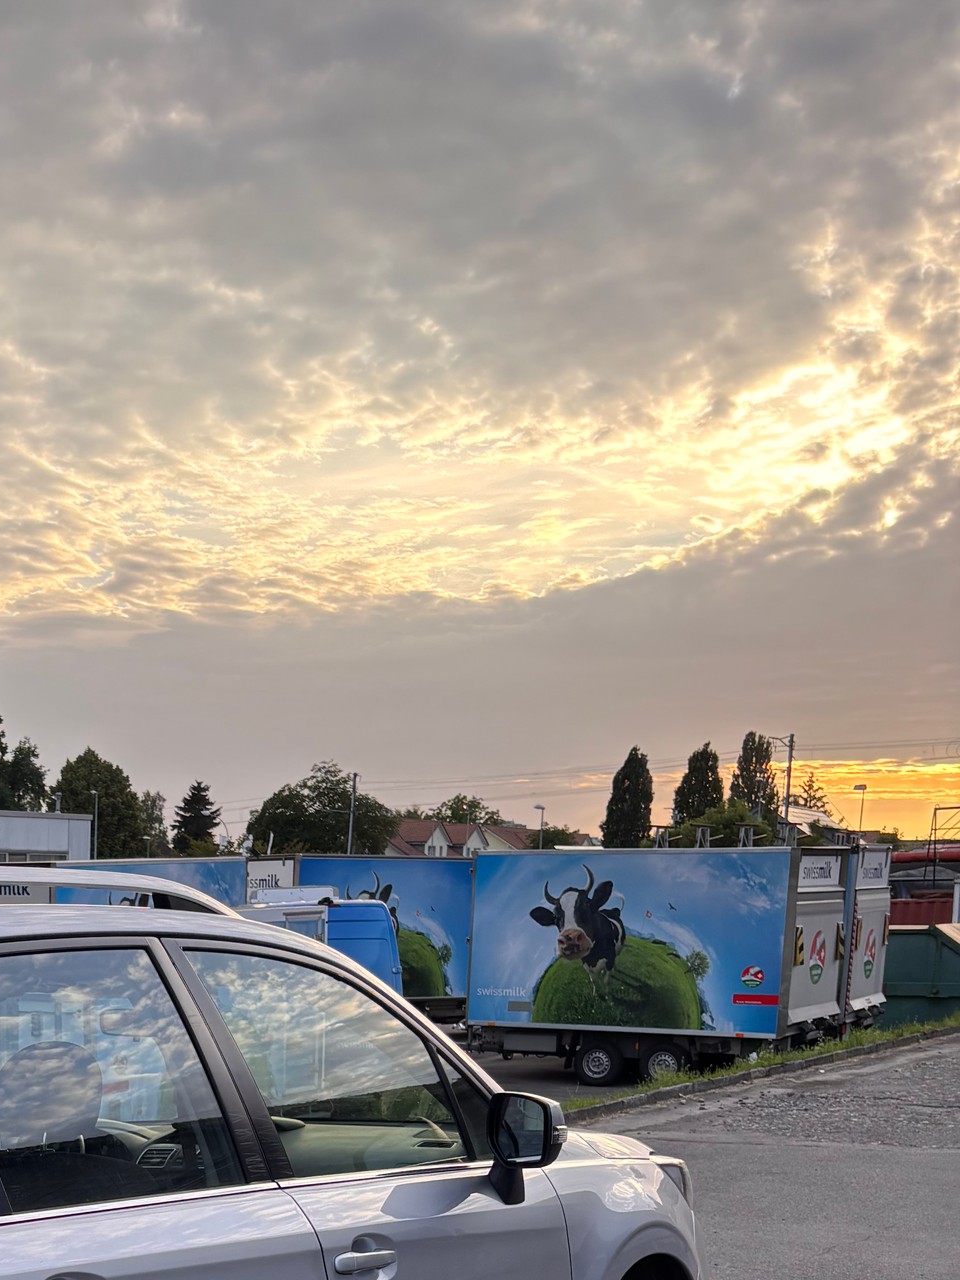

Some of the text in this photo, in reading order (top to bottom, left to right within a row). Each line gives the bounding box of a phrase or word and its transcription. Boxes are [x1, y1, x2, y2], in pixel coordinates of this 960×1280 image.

[802, 861, 833, 880] swissmilk
[862, 861, 884, 880] swissmilk
[476, 986, 526, 998] swissmilk
